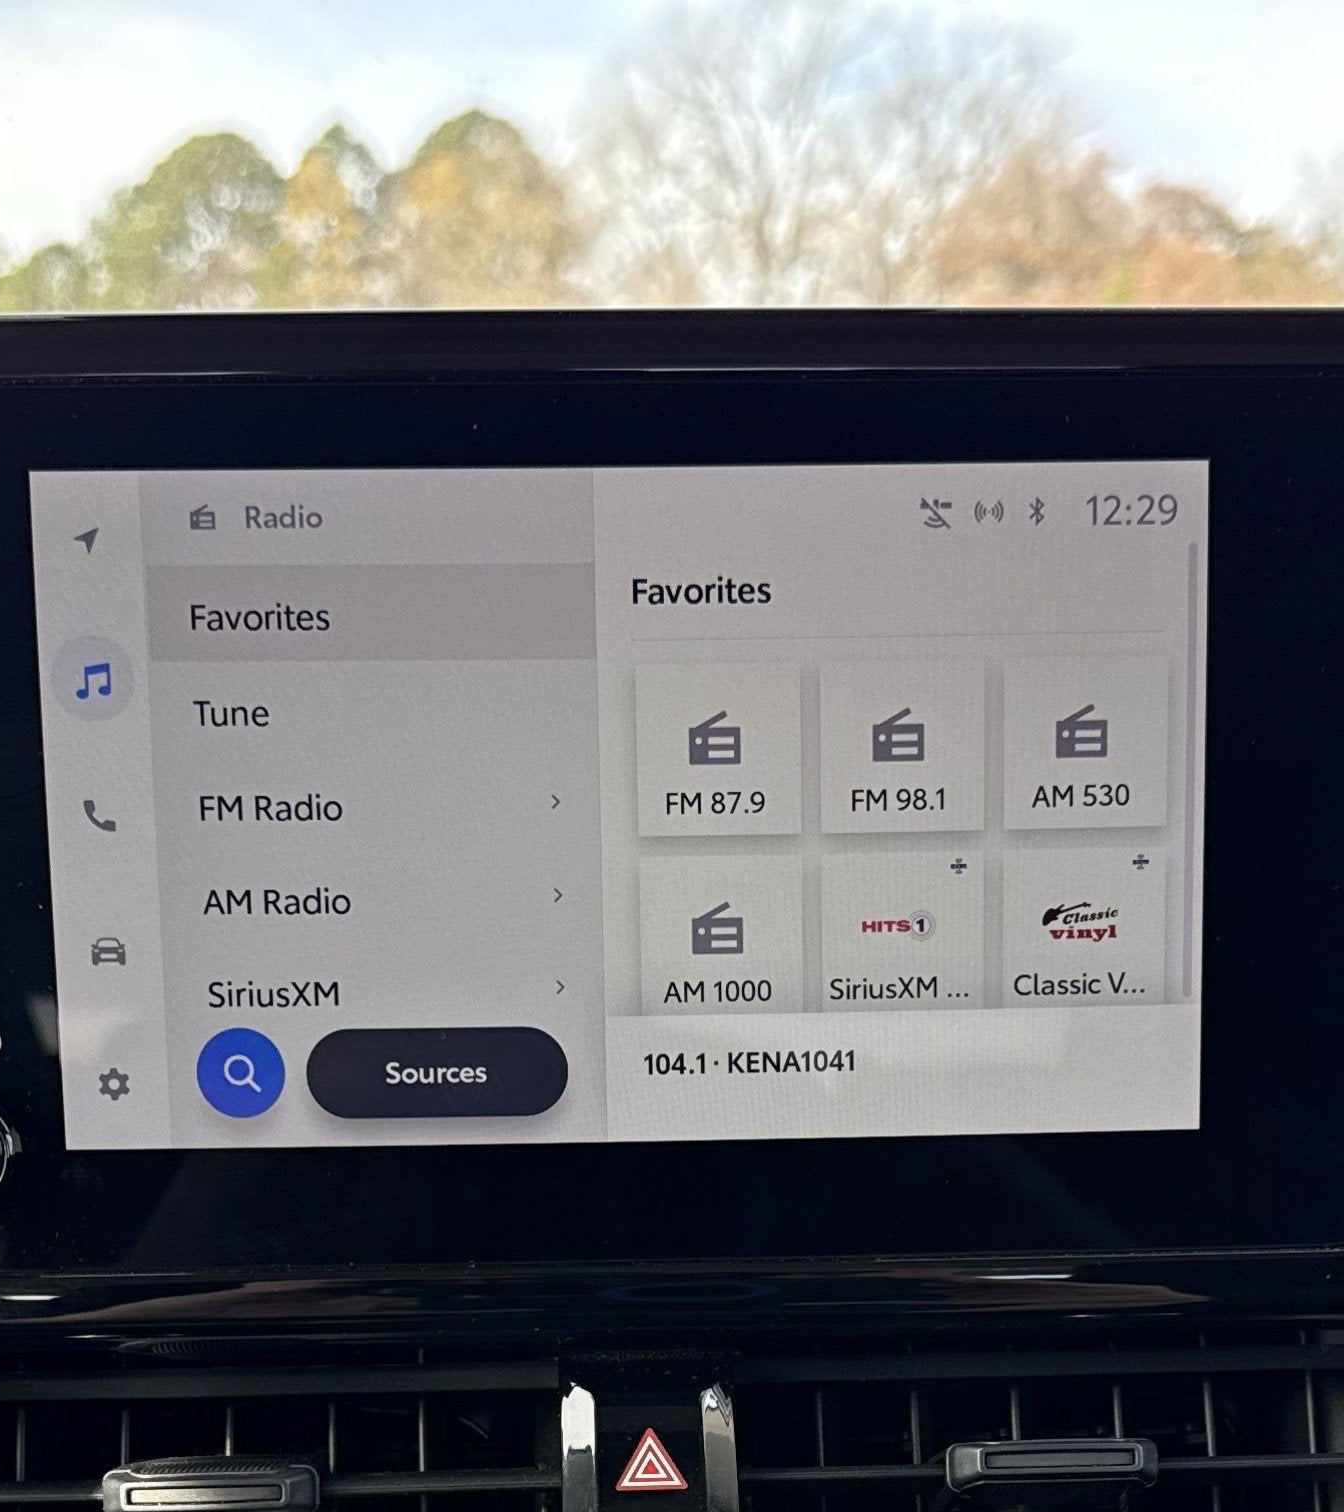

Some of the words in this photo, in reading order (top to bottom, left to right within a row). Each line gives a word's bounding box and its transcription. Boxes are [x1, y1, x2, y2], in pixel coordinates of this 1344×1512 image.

[244, 504, 323, 530] Radio
[1086, 493, 1179, 527] 12:29
[632, 575, 772, 606] Favorites
[189, 602, 331, 632] Favorites
[192, 700, 271, 728] Tune
[199, 795, 244, 823] FM
[254, 793, 344, 823] Radio
[665, 791, 703, 816] FM
[710, 790, 767, 816] 87.9
[850, 788, 889, 813] FM
[895, 786, 946, 812] 98.1
[1031, 784, 1075, 809] AM
[1082, 783, 1131, 808] 530
[203, 888, 253, 916] AM
[263, 886, 352, 916] Radio
[861, 919, 912, 934] HITS
[1062, 906, 1119, 926] Classic
[1049, 924, 1118, 943] vinyl
[208, 980, 340, 1009] SiriusXM
[663, 980, 706, 1005] AM
[713, 978, 773, 1004] 1000
[828, 975, 938, 1002] SiriusXM
[1013, 972, 1101, 998] Classic
[385, 1061, 488, 1086] Sources
[644, 1051, 707, 1077] 104.1
[727, 1048, 855, 1076] KENA1041
